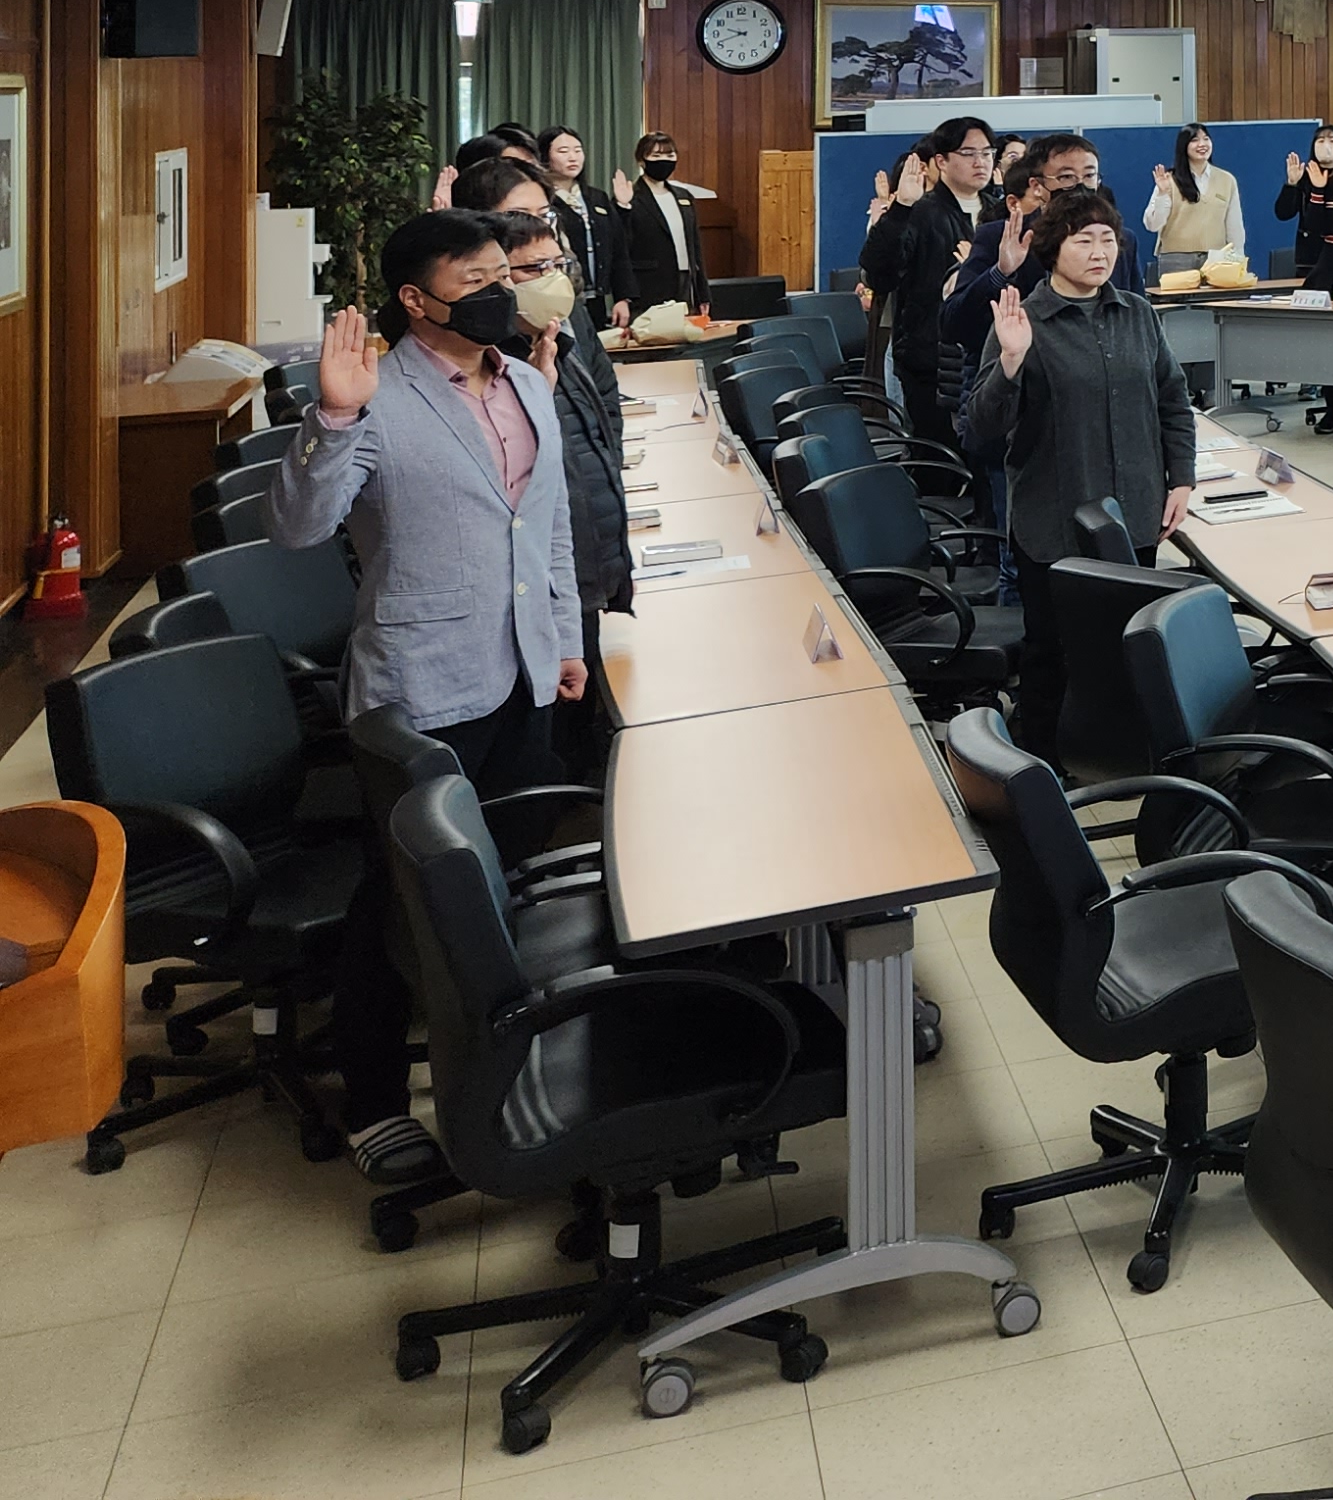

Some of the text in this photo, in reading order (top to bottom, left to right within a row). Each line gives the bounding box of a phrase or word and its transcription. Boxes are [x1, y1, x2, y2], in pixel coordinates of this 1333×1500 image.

[726, 10, 734, 19] 11
[737, 7, 747, 16] 12
[752, 10, 758, 19] 1
[716, 19, 726, 28] 10
[760, 18, 769, 27] 2
[712, 29, 721, 39] 9
[763, 29, 772, 38] 3
[716, 40, 725, 50] 8
[760, 39, 768, 49] 4
[726, 49, 735, 58] 7
[738, 51, 746, 62] 6
[750, 48, 759, 58] 5
